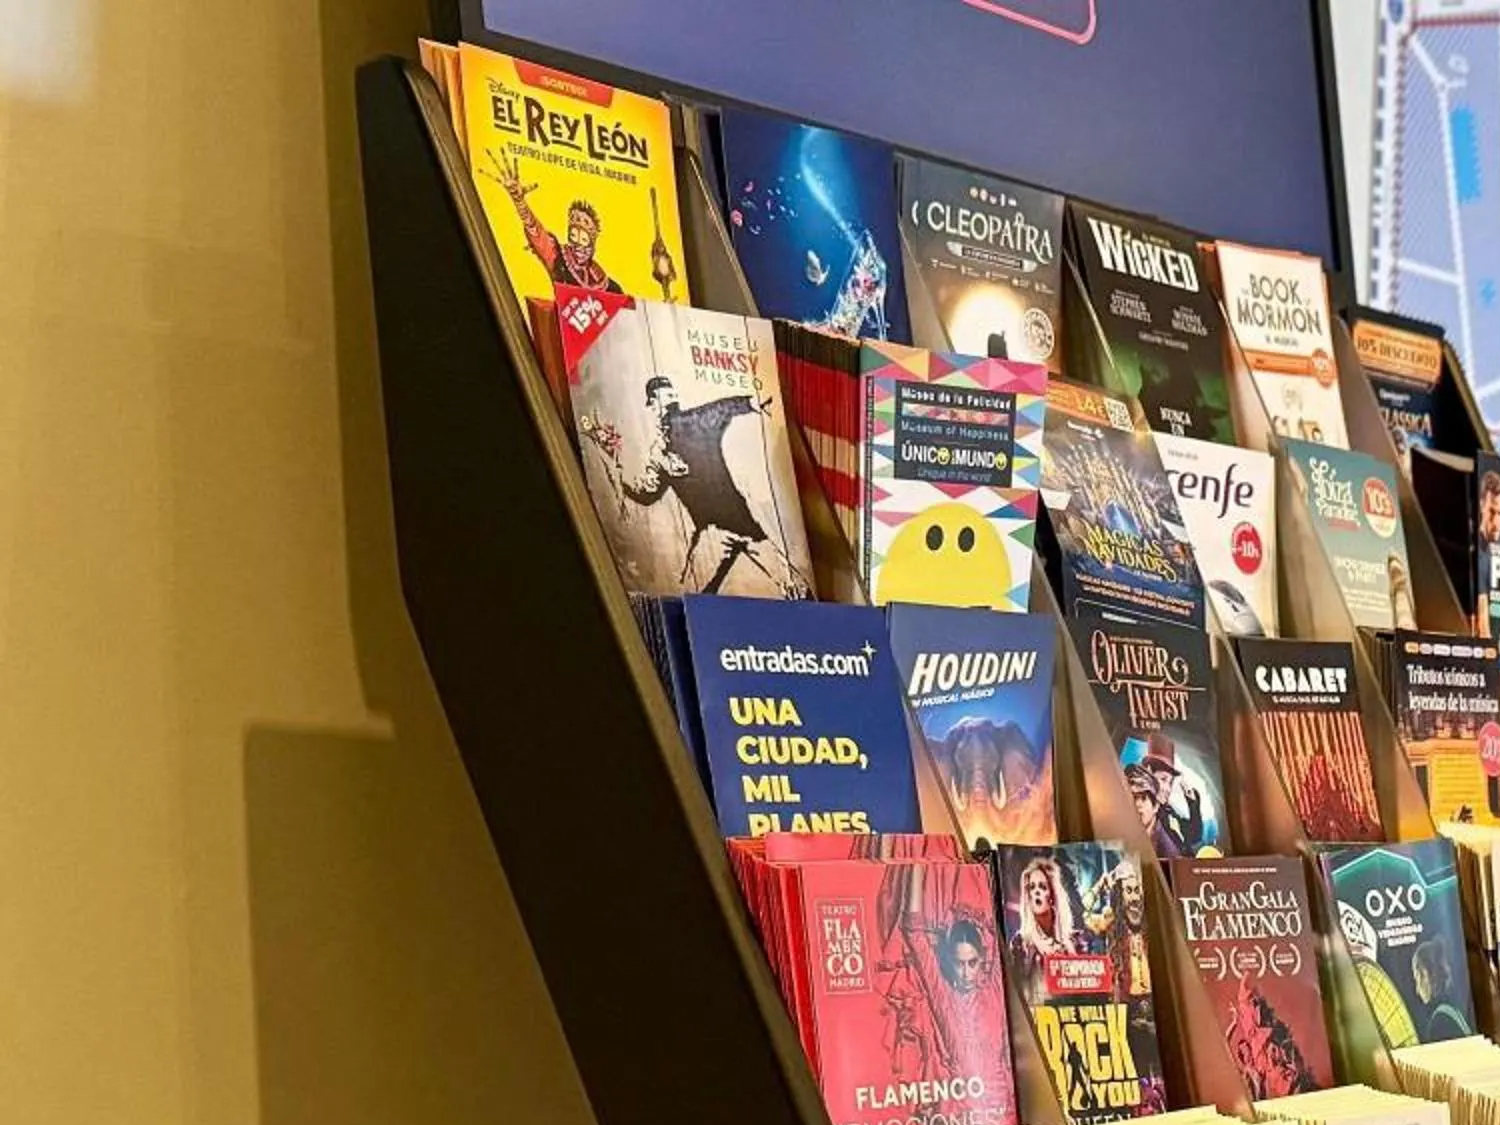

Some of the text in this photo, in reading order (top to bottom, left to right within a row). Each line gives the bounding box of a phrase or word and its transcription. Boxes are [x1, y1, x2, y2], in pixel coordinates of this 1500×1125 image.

[491, 95, 649, 162] EL REY LEÓN
[926, 201, 1053, 265] CLEOPATRA
[1249, 274, 1303, 304] BOOK
[567, 296, 603, 334] 15%
[1237, 297, 1323, 336] MORMON
[688, 329, 758, 353] MUSEU
[691, 345, 760, 376] BANKSY
[695, 370, 763, 391] MUSEO
[1166, 463, 1254, 519] renfe
[720, 644, 870, 677] entradas.com
[1091, 629, 1189, 686] OLIVER
[908, 651, 1038, 697] HOUDINI
[1255, 664, 1347, 694] CABARET
[729, 697, 802, 726] UNA
[1110, 679, 1189, 729] TWIST
[736, 735, 868, 770] CIUDAD,
[742, 775, 801, 803] MIL
[1199, 881, 1298, 911] GRAN GALA
[1365, 883, 1426, 917] OXO
[823, 919, 861, 941] FLA
[1180, 897, 1302, 941] FLAMENCO
[827, 940, 861, 955] MEN
[826, 953, 864, 976] CO
[829, 977, 865, 989] MADRID
[1059, 1005, 1077, 1023] WE
[855, 1075, 985, 1111] FLAMENCO
[1090, 1080, 1141, 1108] YOU
